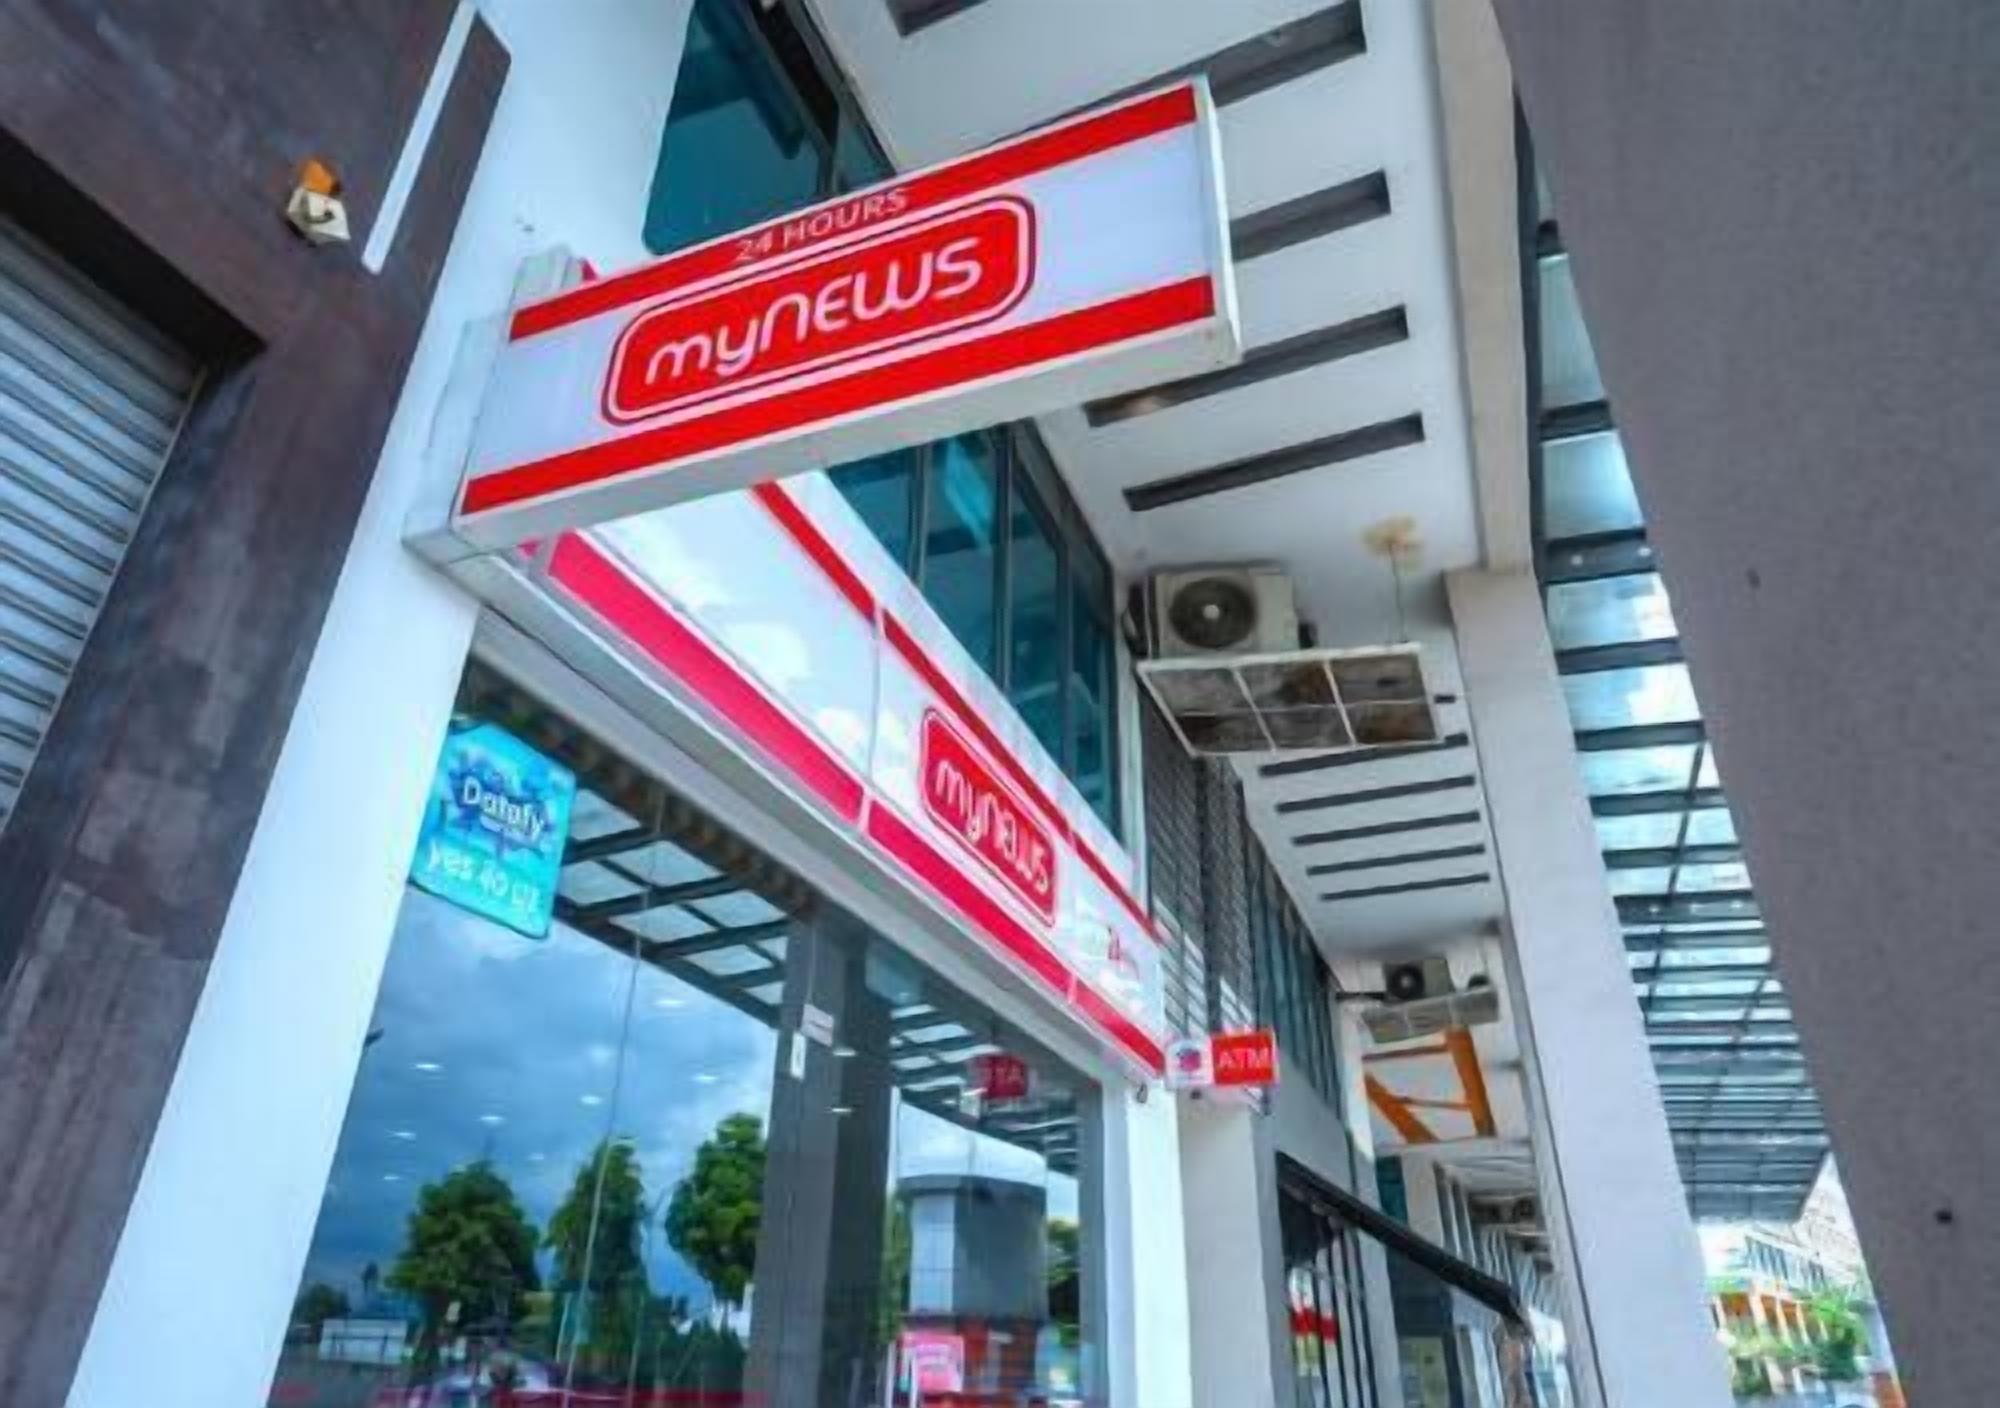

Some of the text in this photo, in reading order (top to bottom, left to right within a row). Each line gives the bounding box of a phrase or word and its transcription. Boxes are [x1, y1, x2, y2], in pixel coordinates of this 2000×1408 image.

[734, 188, 908, 262] 24 HOURS
[1218, 1047, 1270, 1070] ATM
